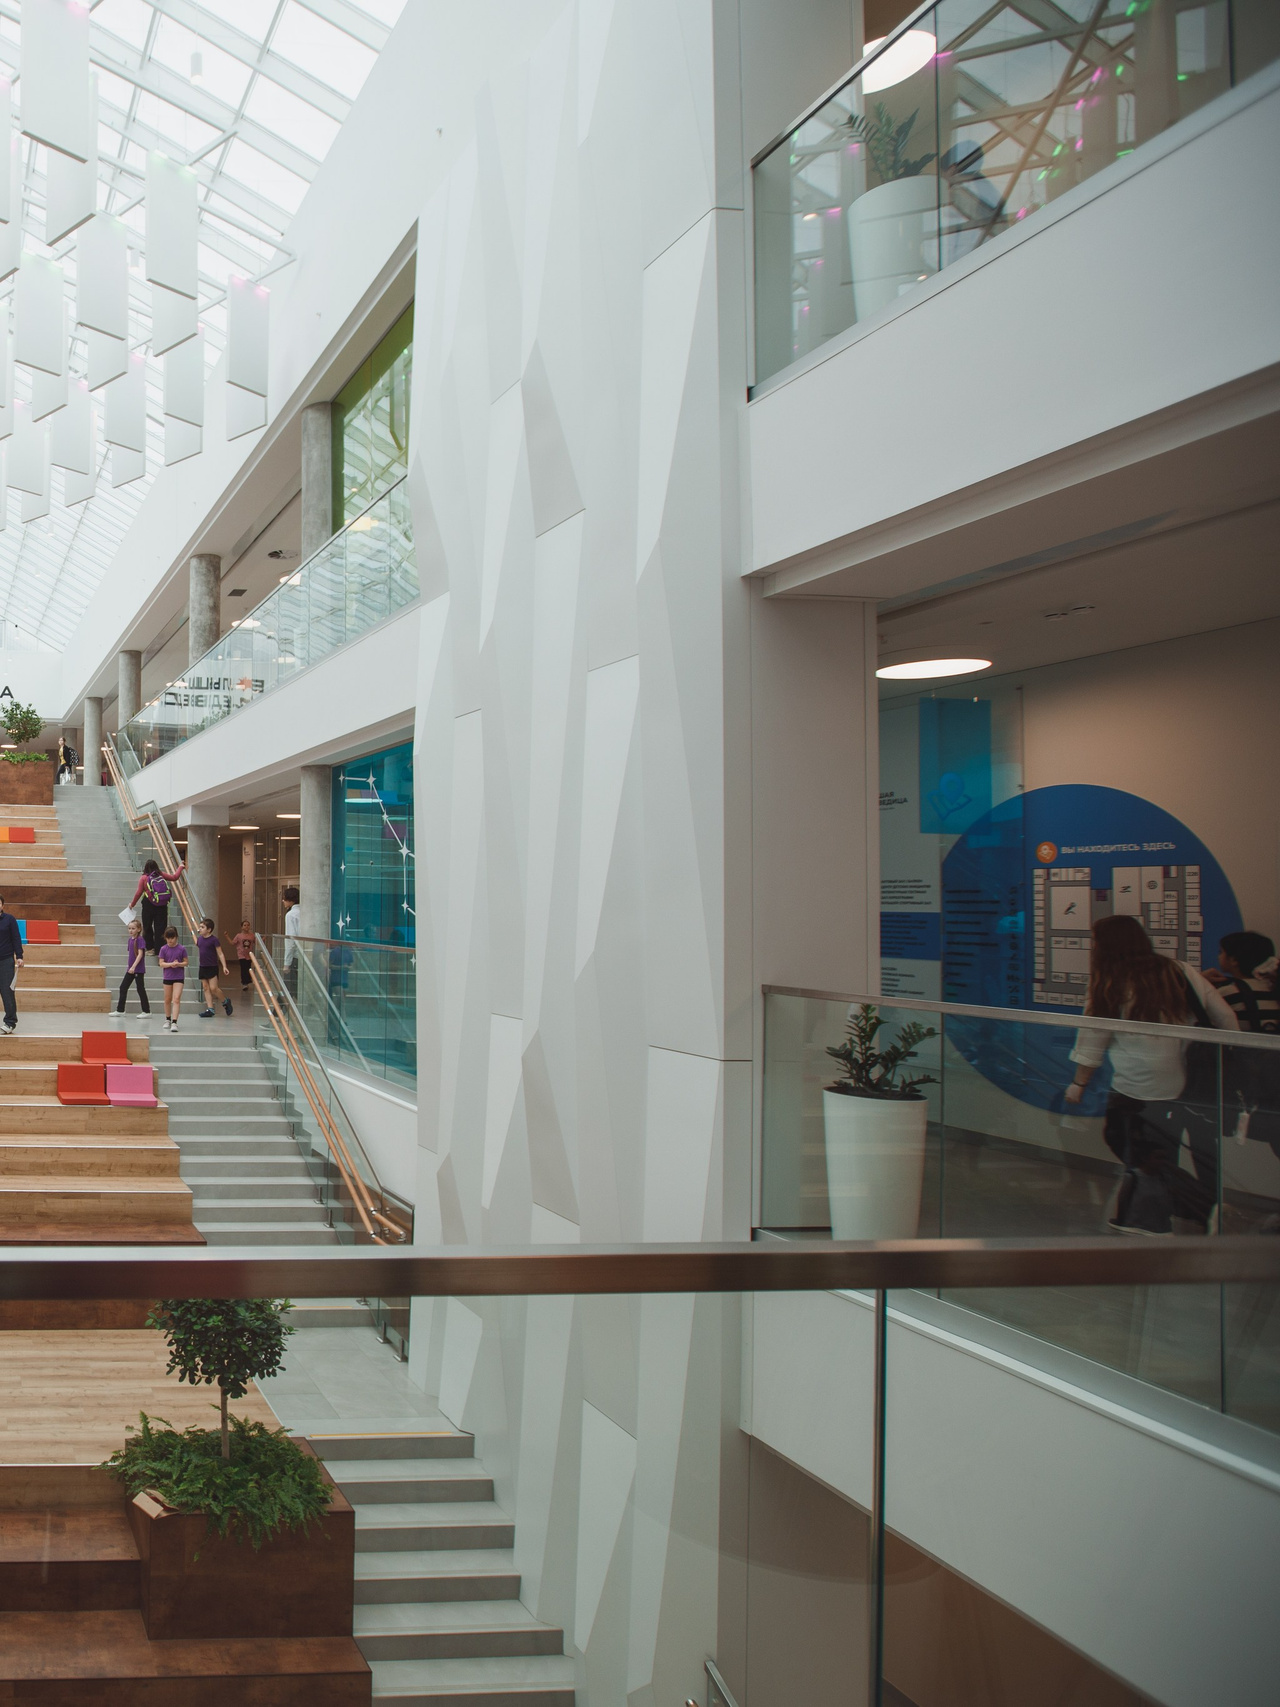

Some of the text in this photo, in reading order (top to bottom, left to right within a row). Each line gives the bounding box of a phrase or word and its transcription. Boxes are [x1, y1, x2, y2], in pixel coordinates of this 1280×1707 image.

[1061, 842, 1176, 854] ВЫ НАХОДИТЕСЬ ЗДЕСЬ
